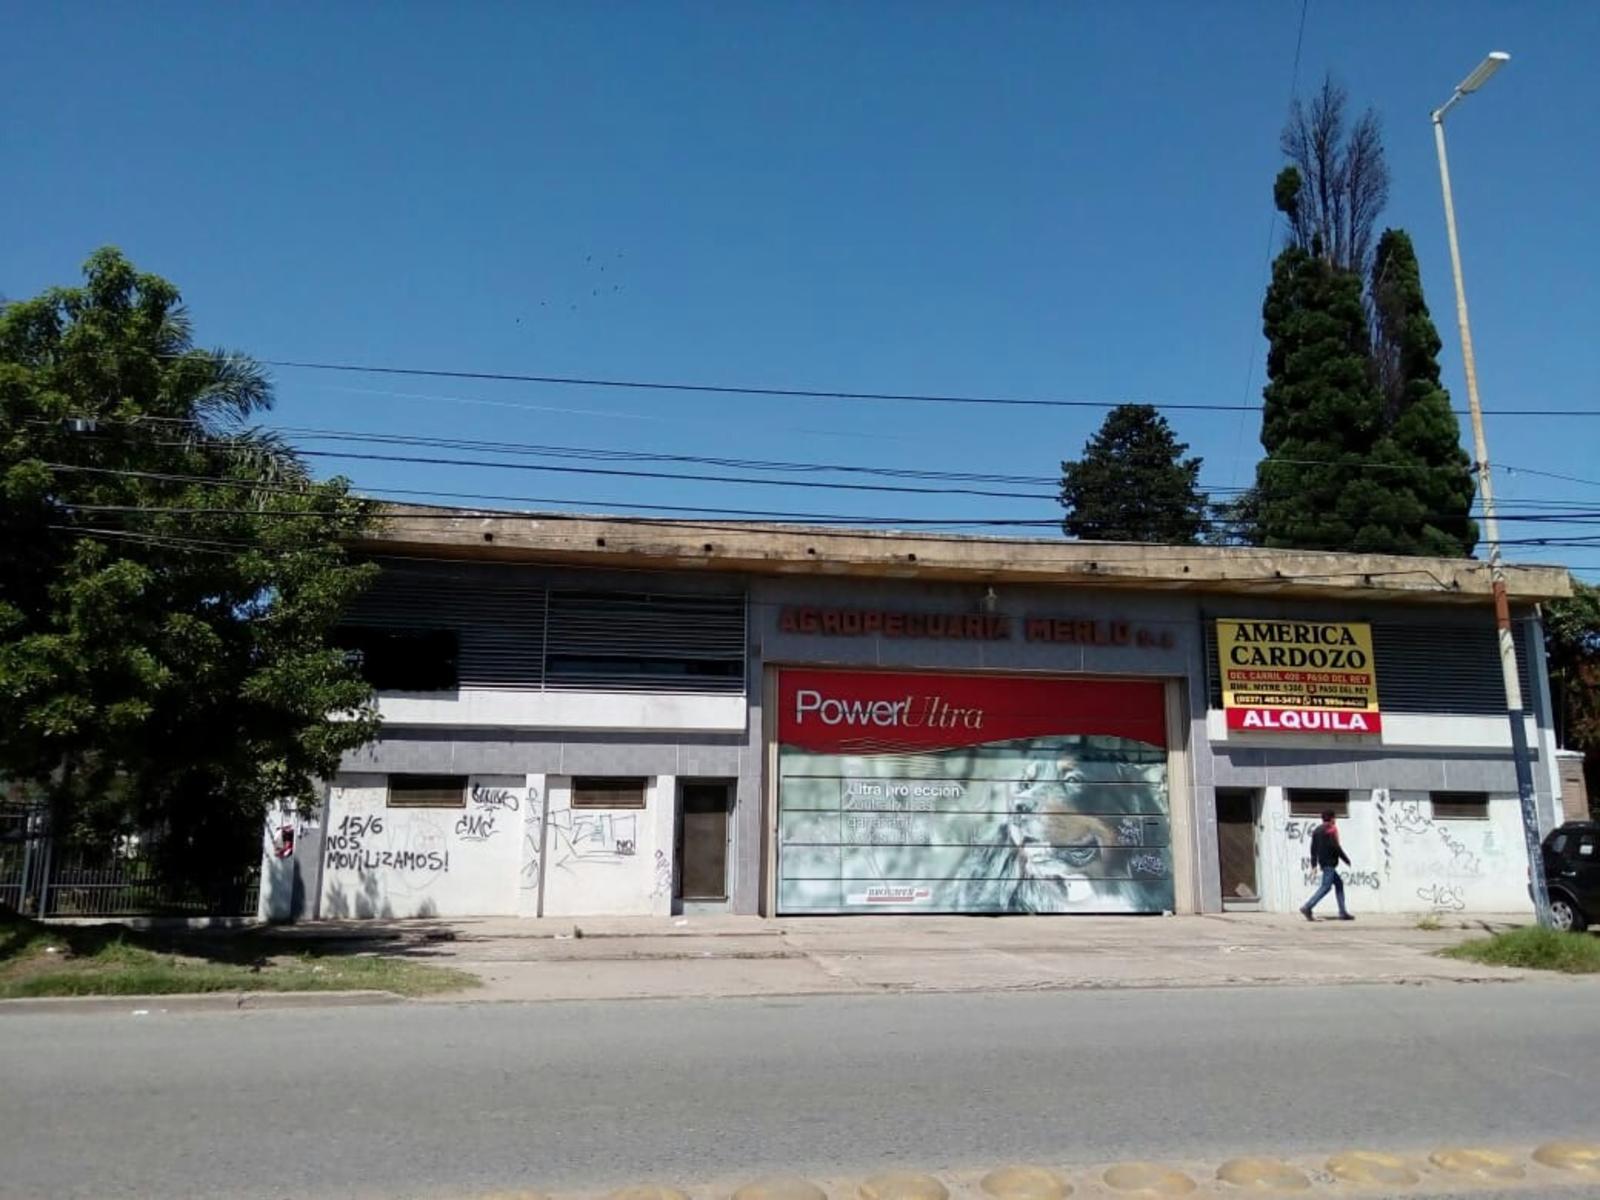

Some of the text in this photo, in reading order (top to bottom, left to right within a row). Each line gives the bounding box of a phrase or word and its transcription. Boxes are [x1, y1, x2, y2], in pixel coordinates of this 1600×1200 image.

[1026, 617, 1134, 646] MERLO
[1234, 623, 1357, 645] AMERICA
[1230, 646, 1366, 669] CARDOZO
[1331, 674, 1348, 682] DEL
[1350, 674, 1367, 683] REY
[1243, 710, 1369, 730] ALQUILA
[339, 815, 383, 837] 15/6
[327, 835, 361, 851] NOS
[326, 849, 449, 872] MOViLiZAMOS!
